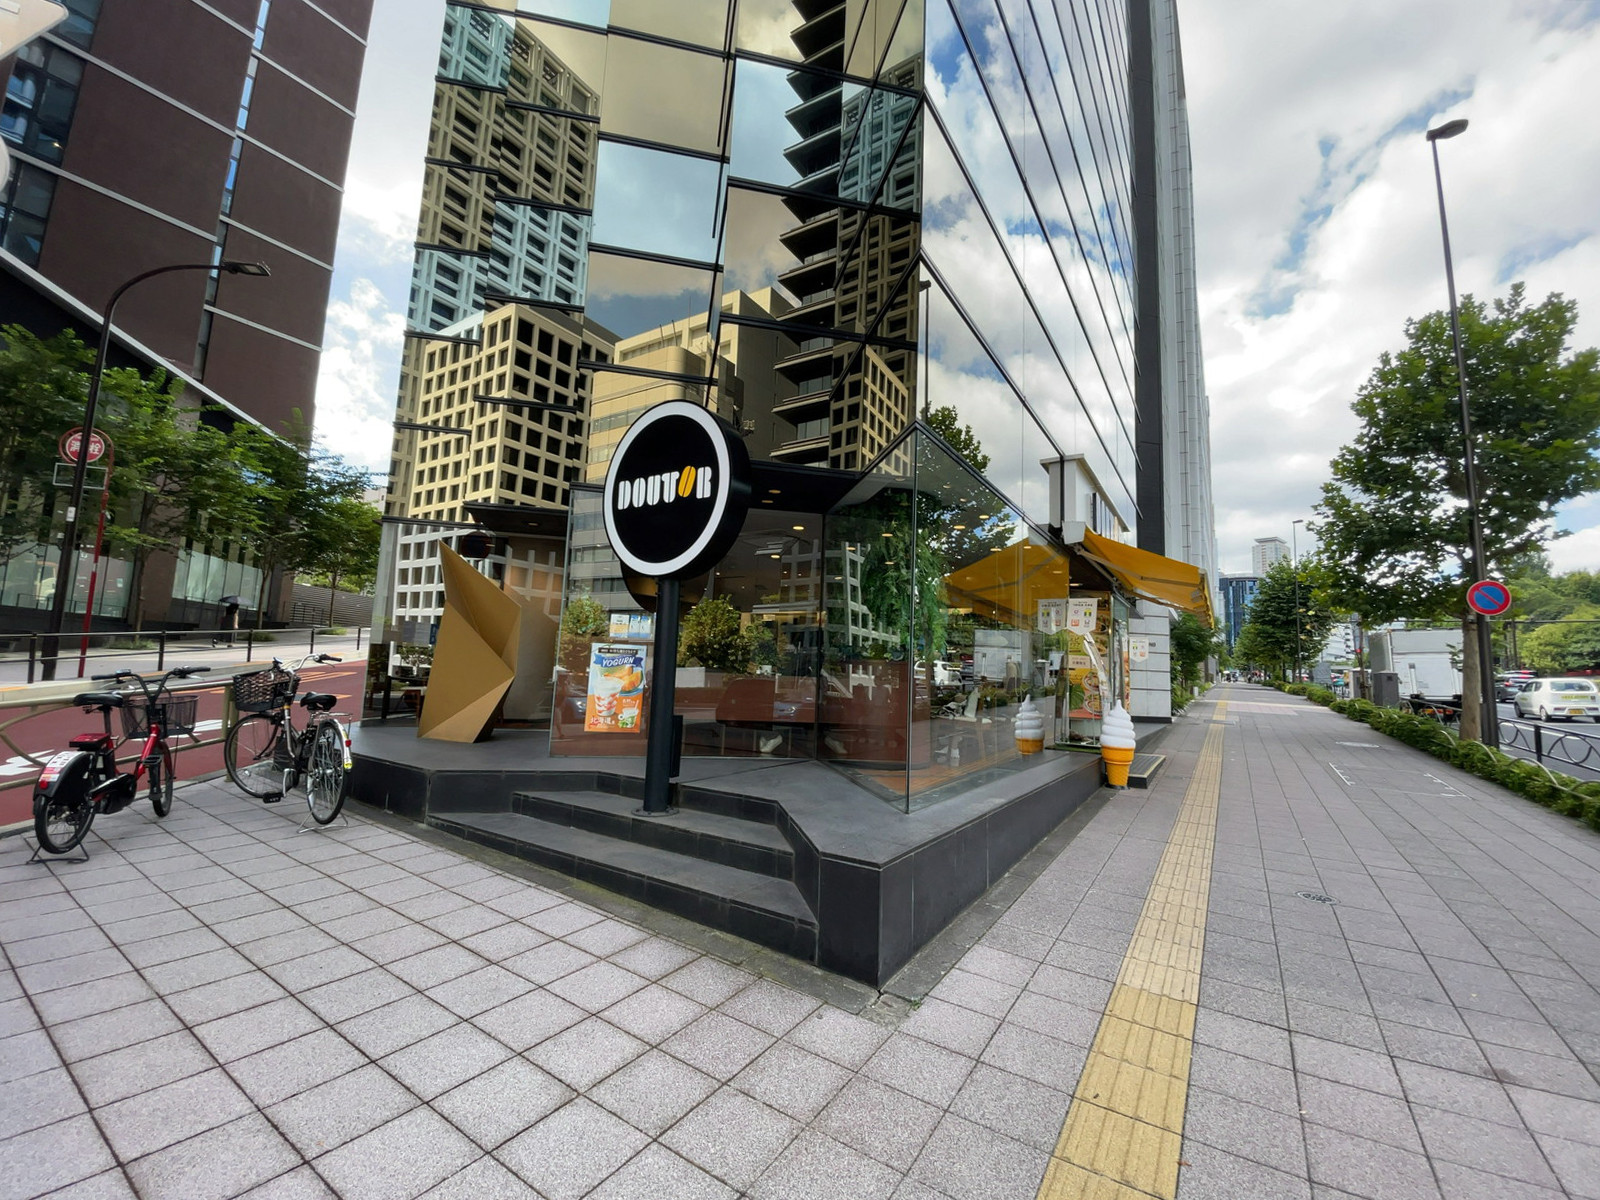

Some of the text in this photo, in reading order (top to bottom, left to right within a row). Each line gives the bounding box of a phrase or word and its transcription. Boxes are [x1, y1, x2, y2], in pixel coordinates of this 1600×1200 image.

[70, 440, 101, 455] 消栓
[617, 465, 712, 510] DOUTOR
[602, 656, 635, 667] YOGURN
